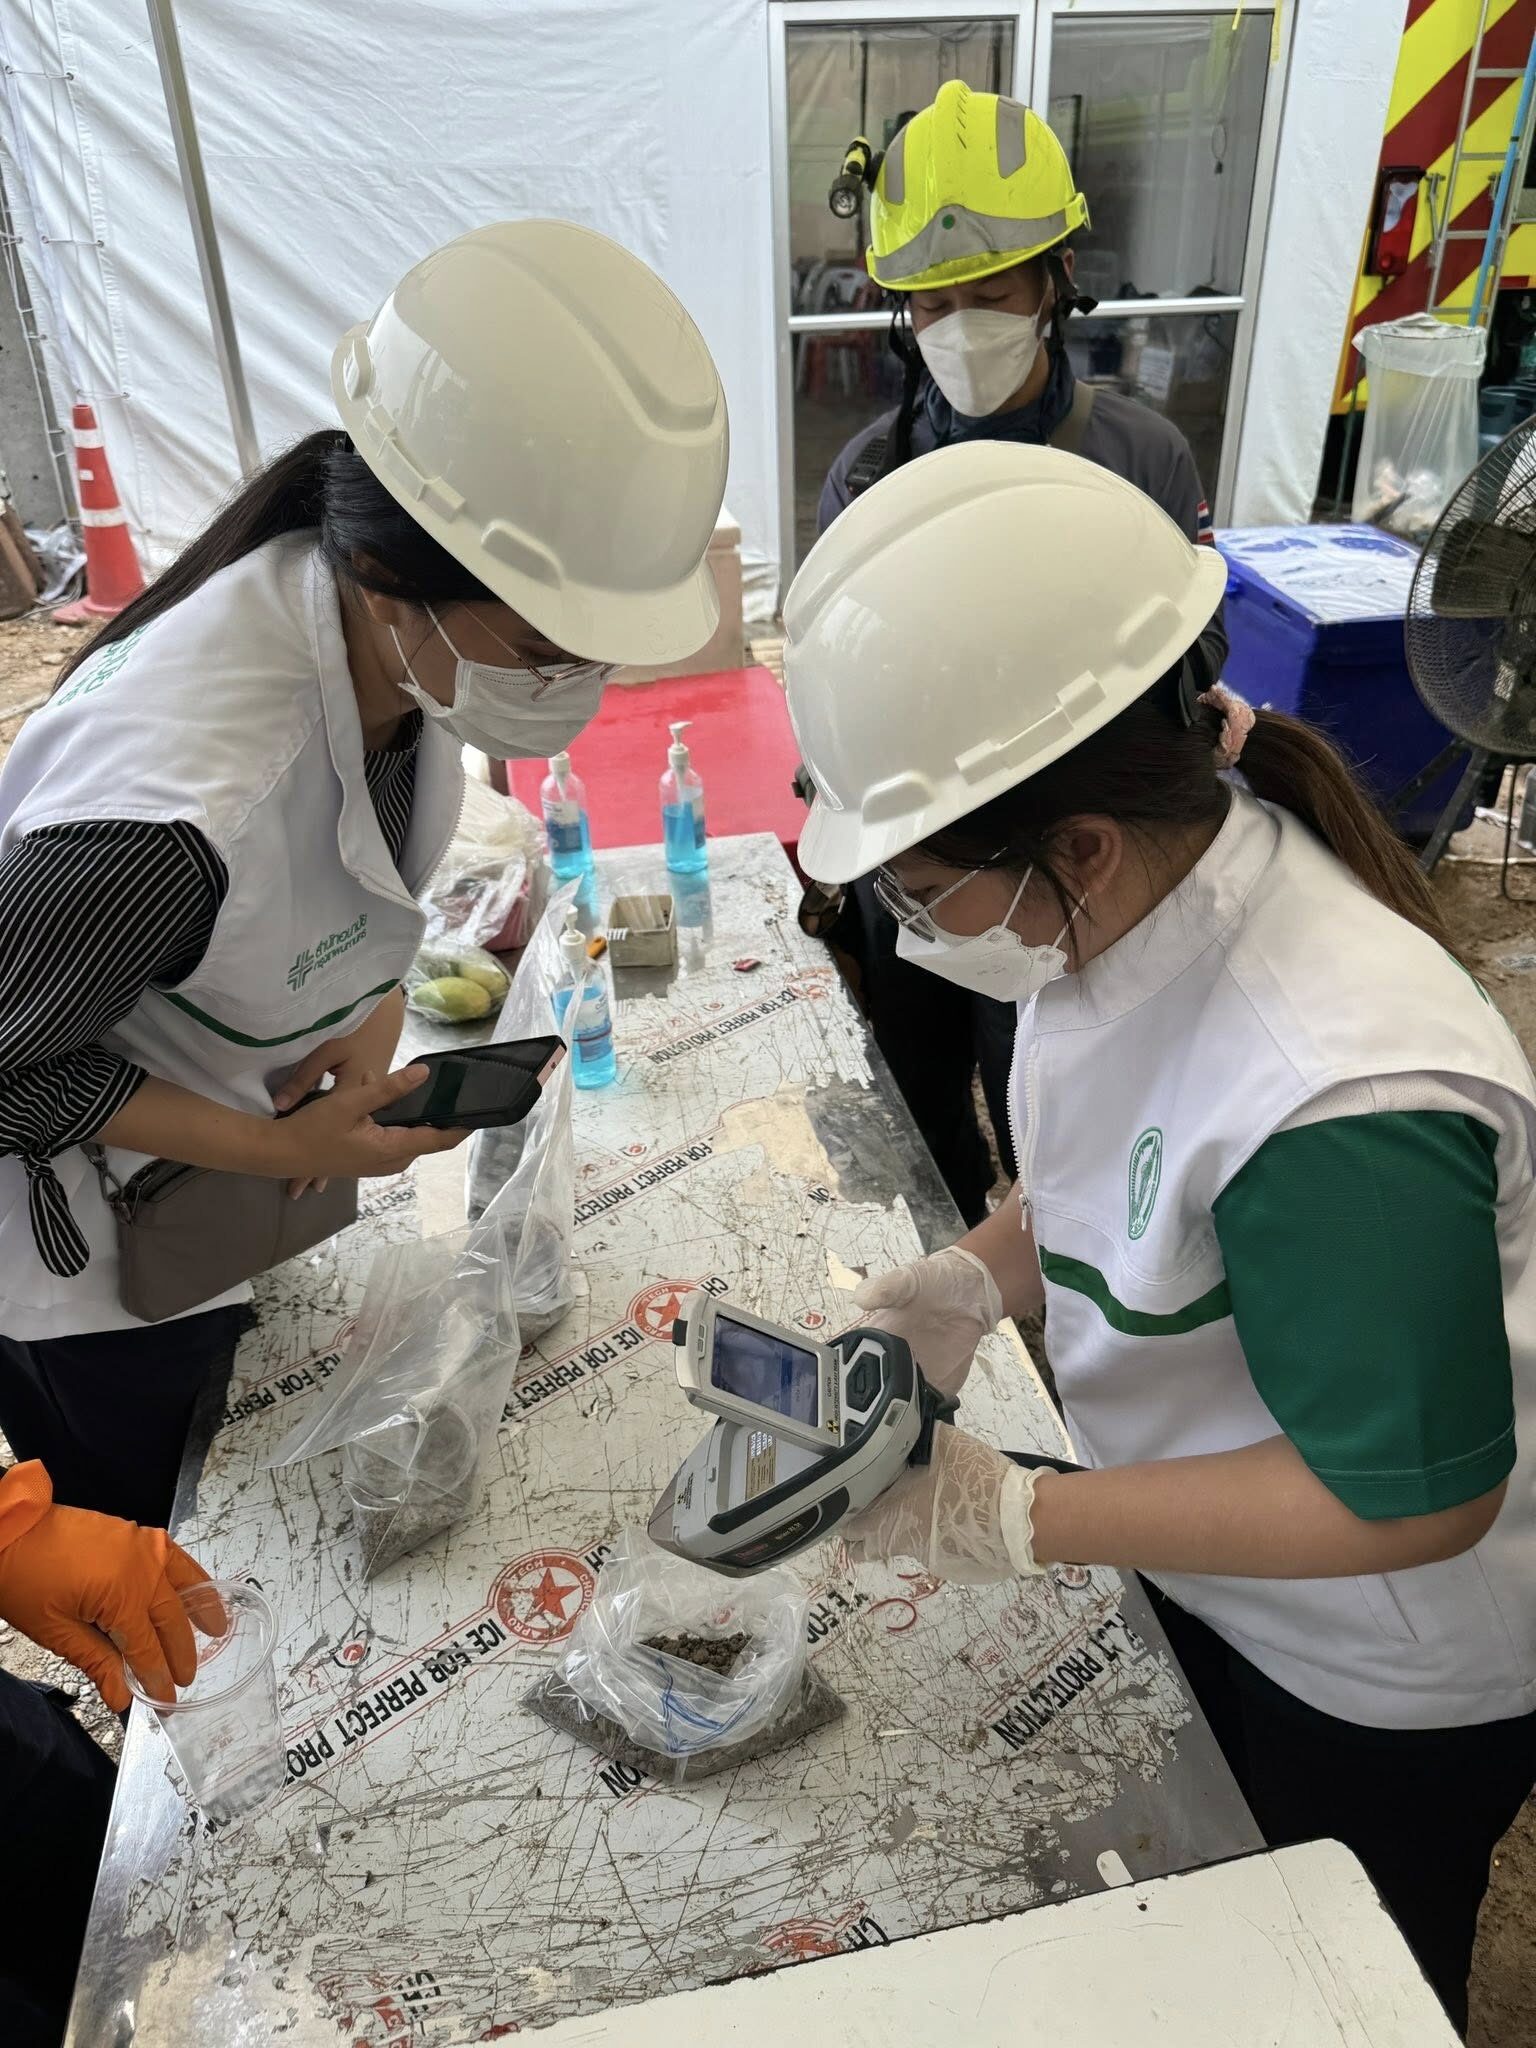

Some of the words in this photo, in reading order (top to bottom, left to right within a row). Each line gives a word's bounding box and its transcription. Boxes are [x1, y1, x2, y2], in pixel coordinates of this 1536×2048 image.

[714, 1008, 761, 1035] PERFECT
[755, 1001, 782, 1014] FOR
[683, 1142, 713, 1161] FOR
[632, 1155, 688, 1190] PERFECT
[700, 1277, 729, 1297] CH
[612, 1326, 645, 1350] ICE
[579, 1341, 619, 1369] FOR
[274, 1368, 316, 1397] FOR
[513, 1360, 586, 1410] PERFECT
[466, 1618, 507, 1655] ICE
[335, 1670, 428, 1747] PERFECT
[992, 1647, 1104, 1751] PROTECTION
